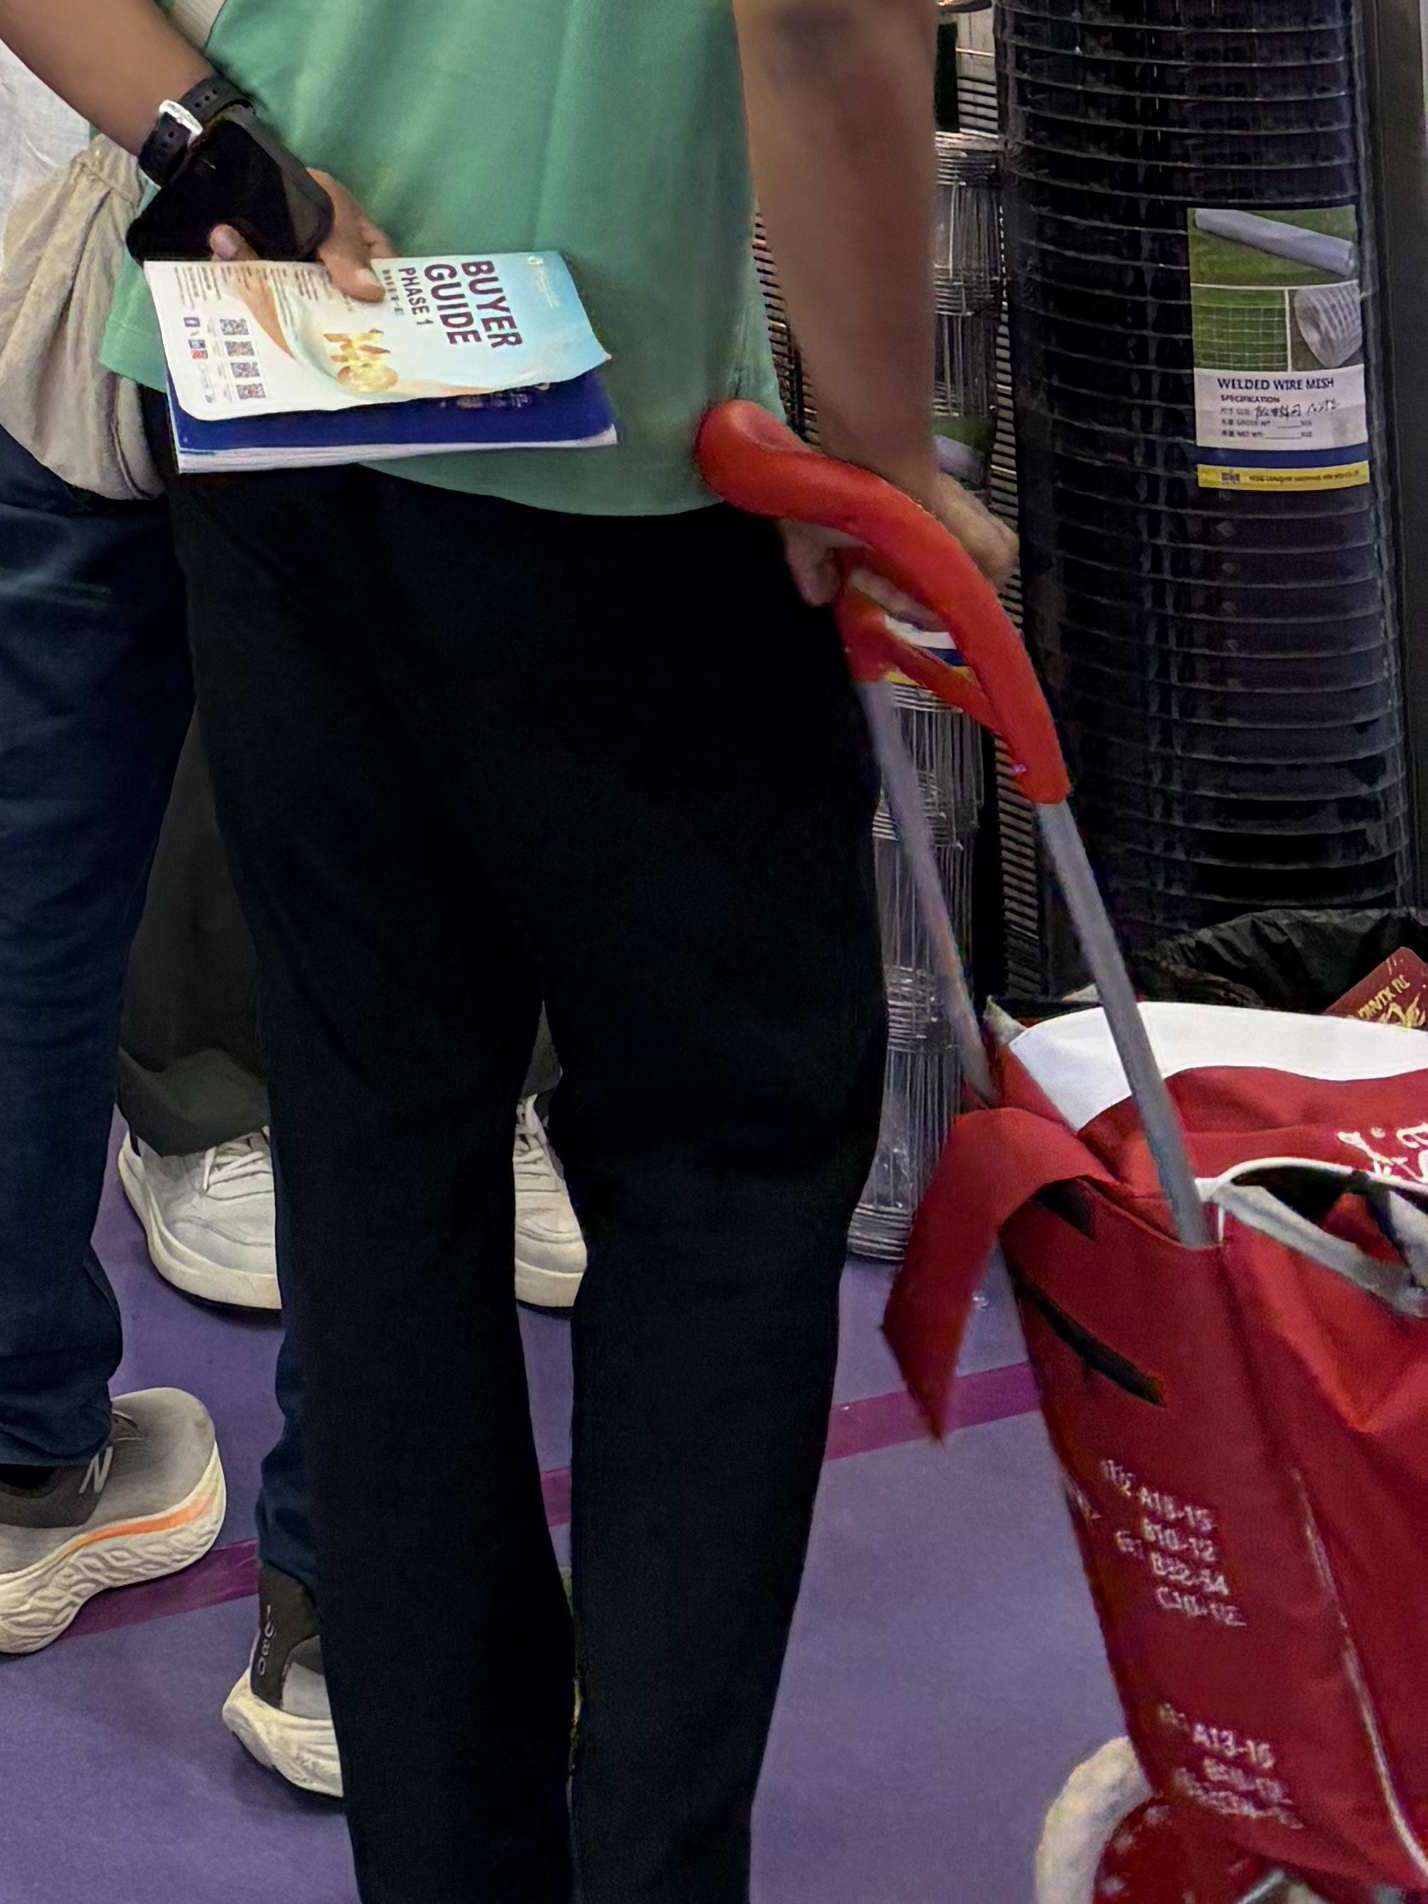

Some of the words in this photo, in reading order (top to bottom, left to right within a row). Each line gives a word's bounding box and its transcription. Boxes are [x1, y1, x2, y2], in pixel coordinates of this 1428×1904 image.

[398, 266, 431, 315] PHASE
[424, 263, 482, 345] GUIDE
[461, 260, 523, 349] BUYER
[1217, 378, 1270, 391] WELDED
[1273, 378, 1302, 391] WIRE
[1306, 377, 1335, 390] MESH
[1220, 395, 1280, 403] SPECIFICATION
